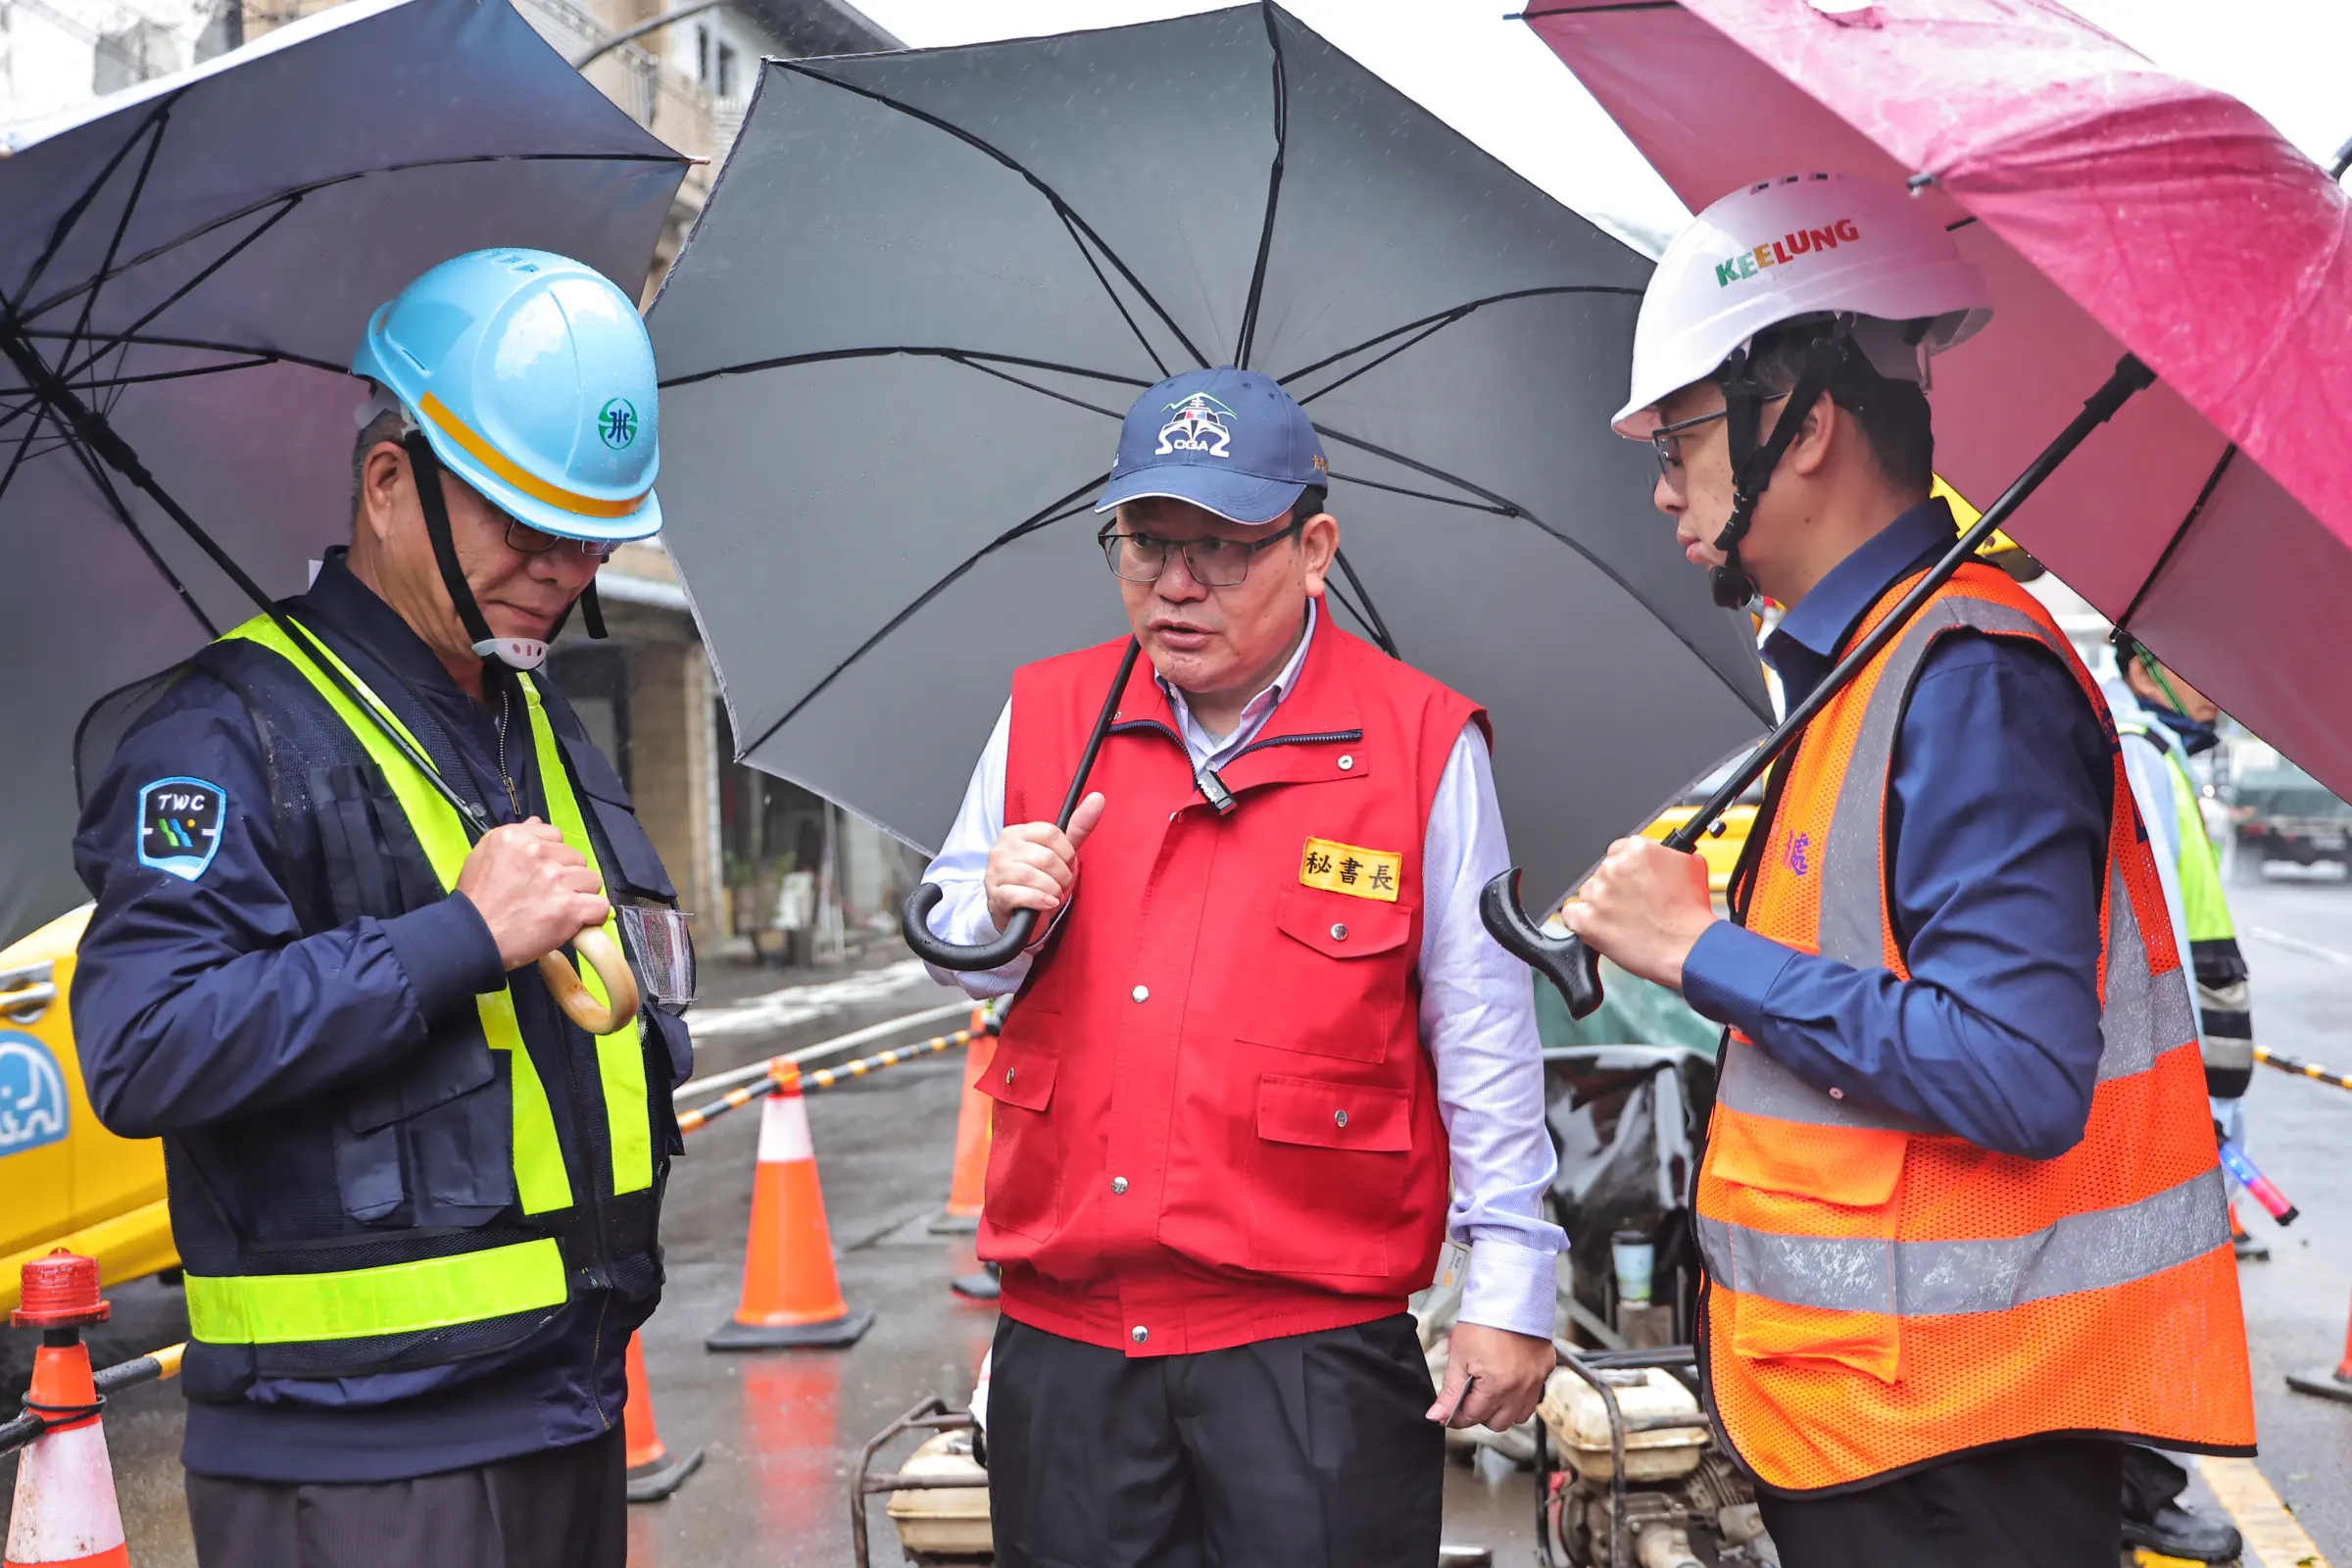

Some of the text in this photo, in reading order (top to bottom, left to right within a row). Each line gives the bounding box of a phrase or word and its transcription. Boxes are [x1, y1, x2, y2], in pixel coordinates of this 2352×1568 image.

[1715, 219, 1860, 288] KEELUNG
[158, 793, 205, 810] TWC
[1305, 851, 1395, 891] 秘書長
